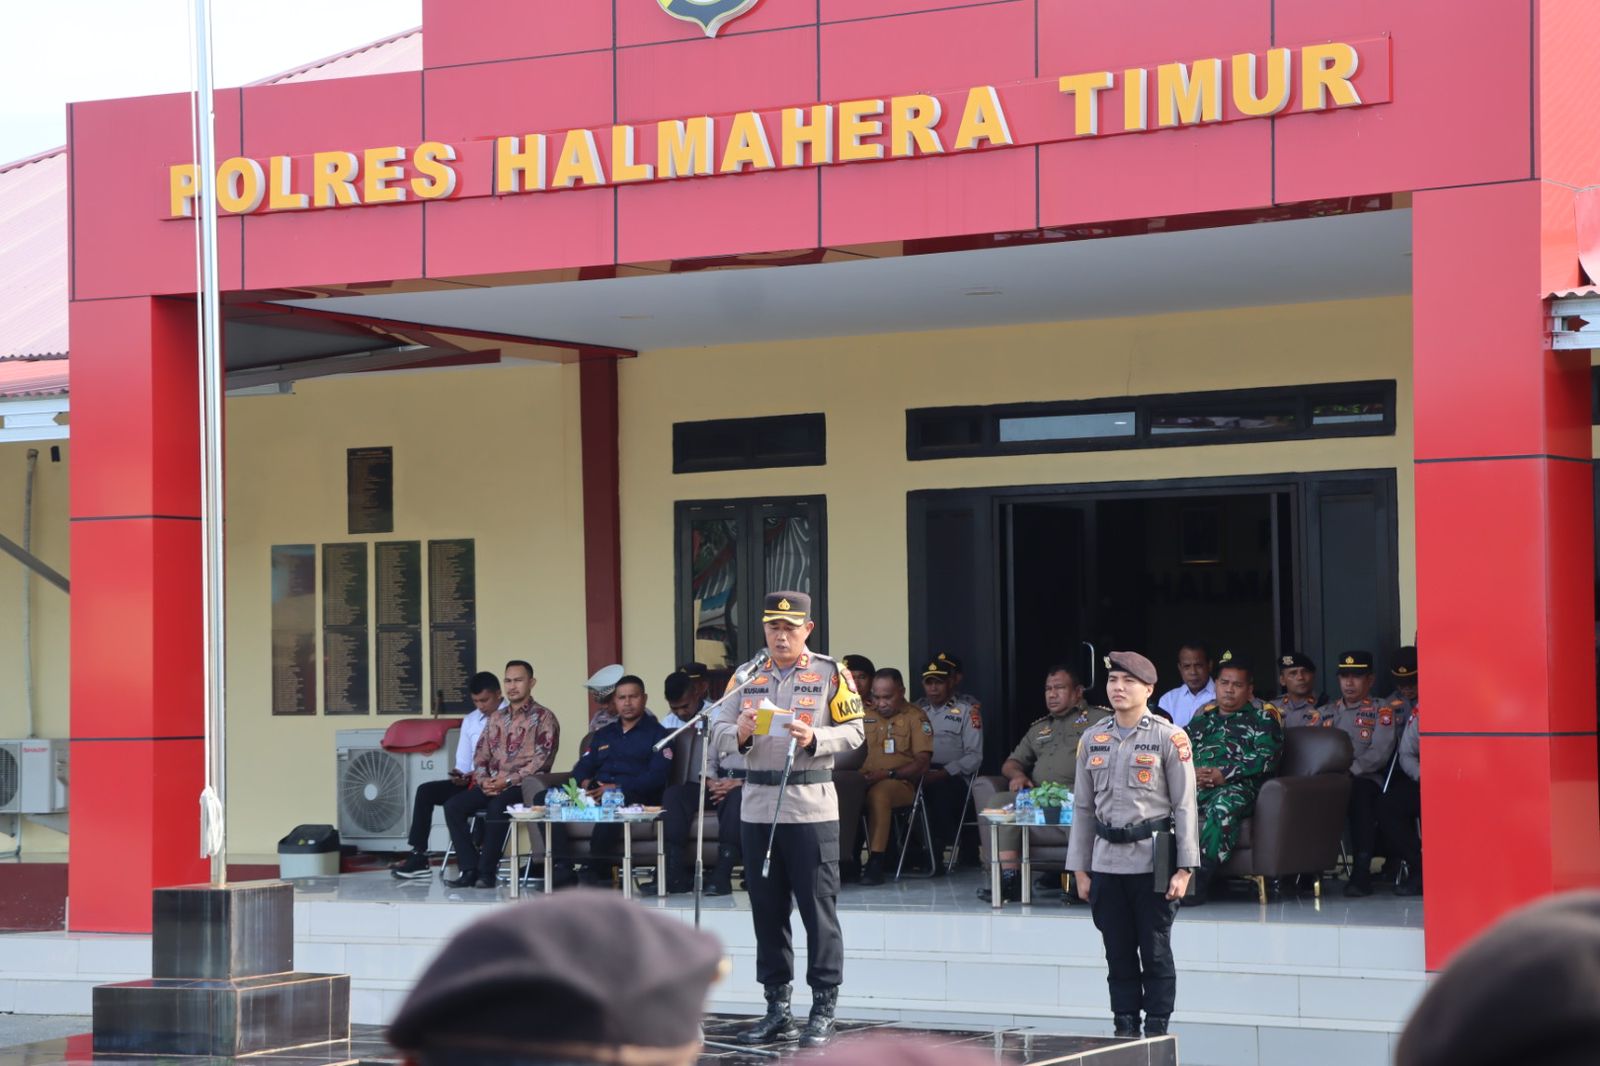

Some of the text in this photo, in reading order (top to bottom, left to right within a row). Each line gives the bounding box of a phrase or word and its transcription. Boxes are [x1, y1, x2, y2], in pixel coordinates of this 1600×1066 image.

[170, 42, 1361, 217] POLRES HALMAHERA TIMUR
[794, 685, 822, 693] POLRI
[944, 715, 962, 723] POLRI
[1134, 744, 1160, 752] POLRI
[420, 760, 434, 770] LG
